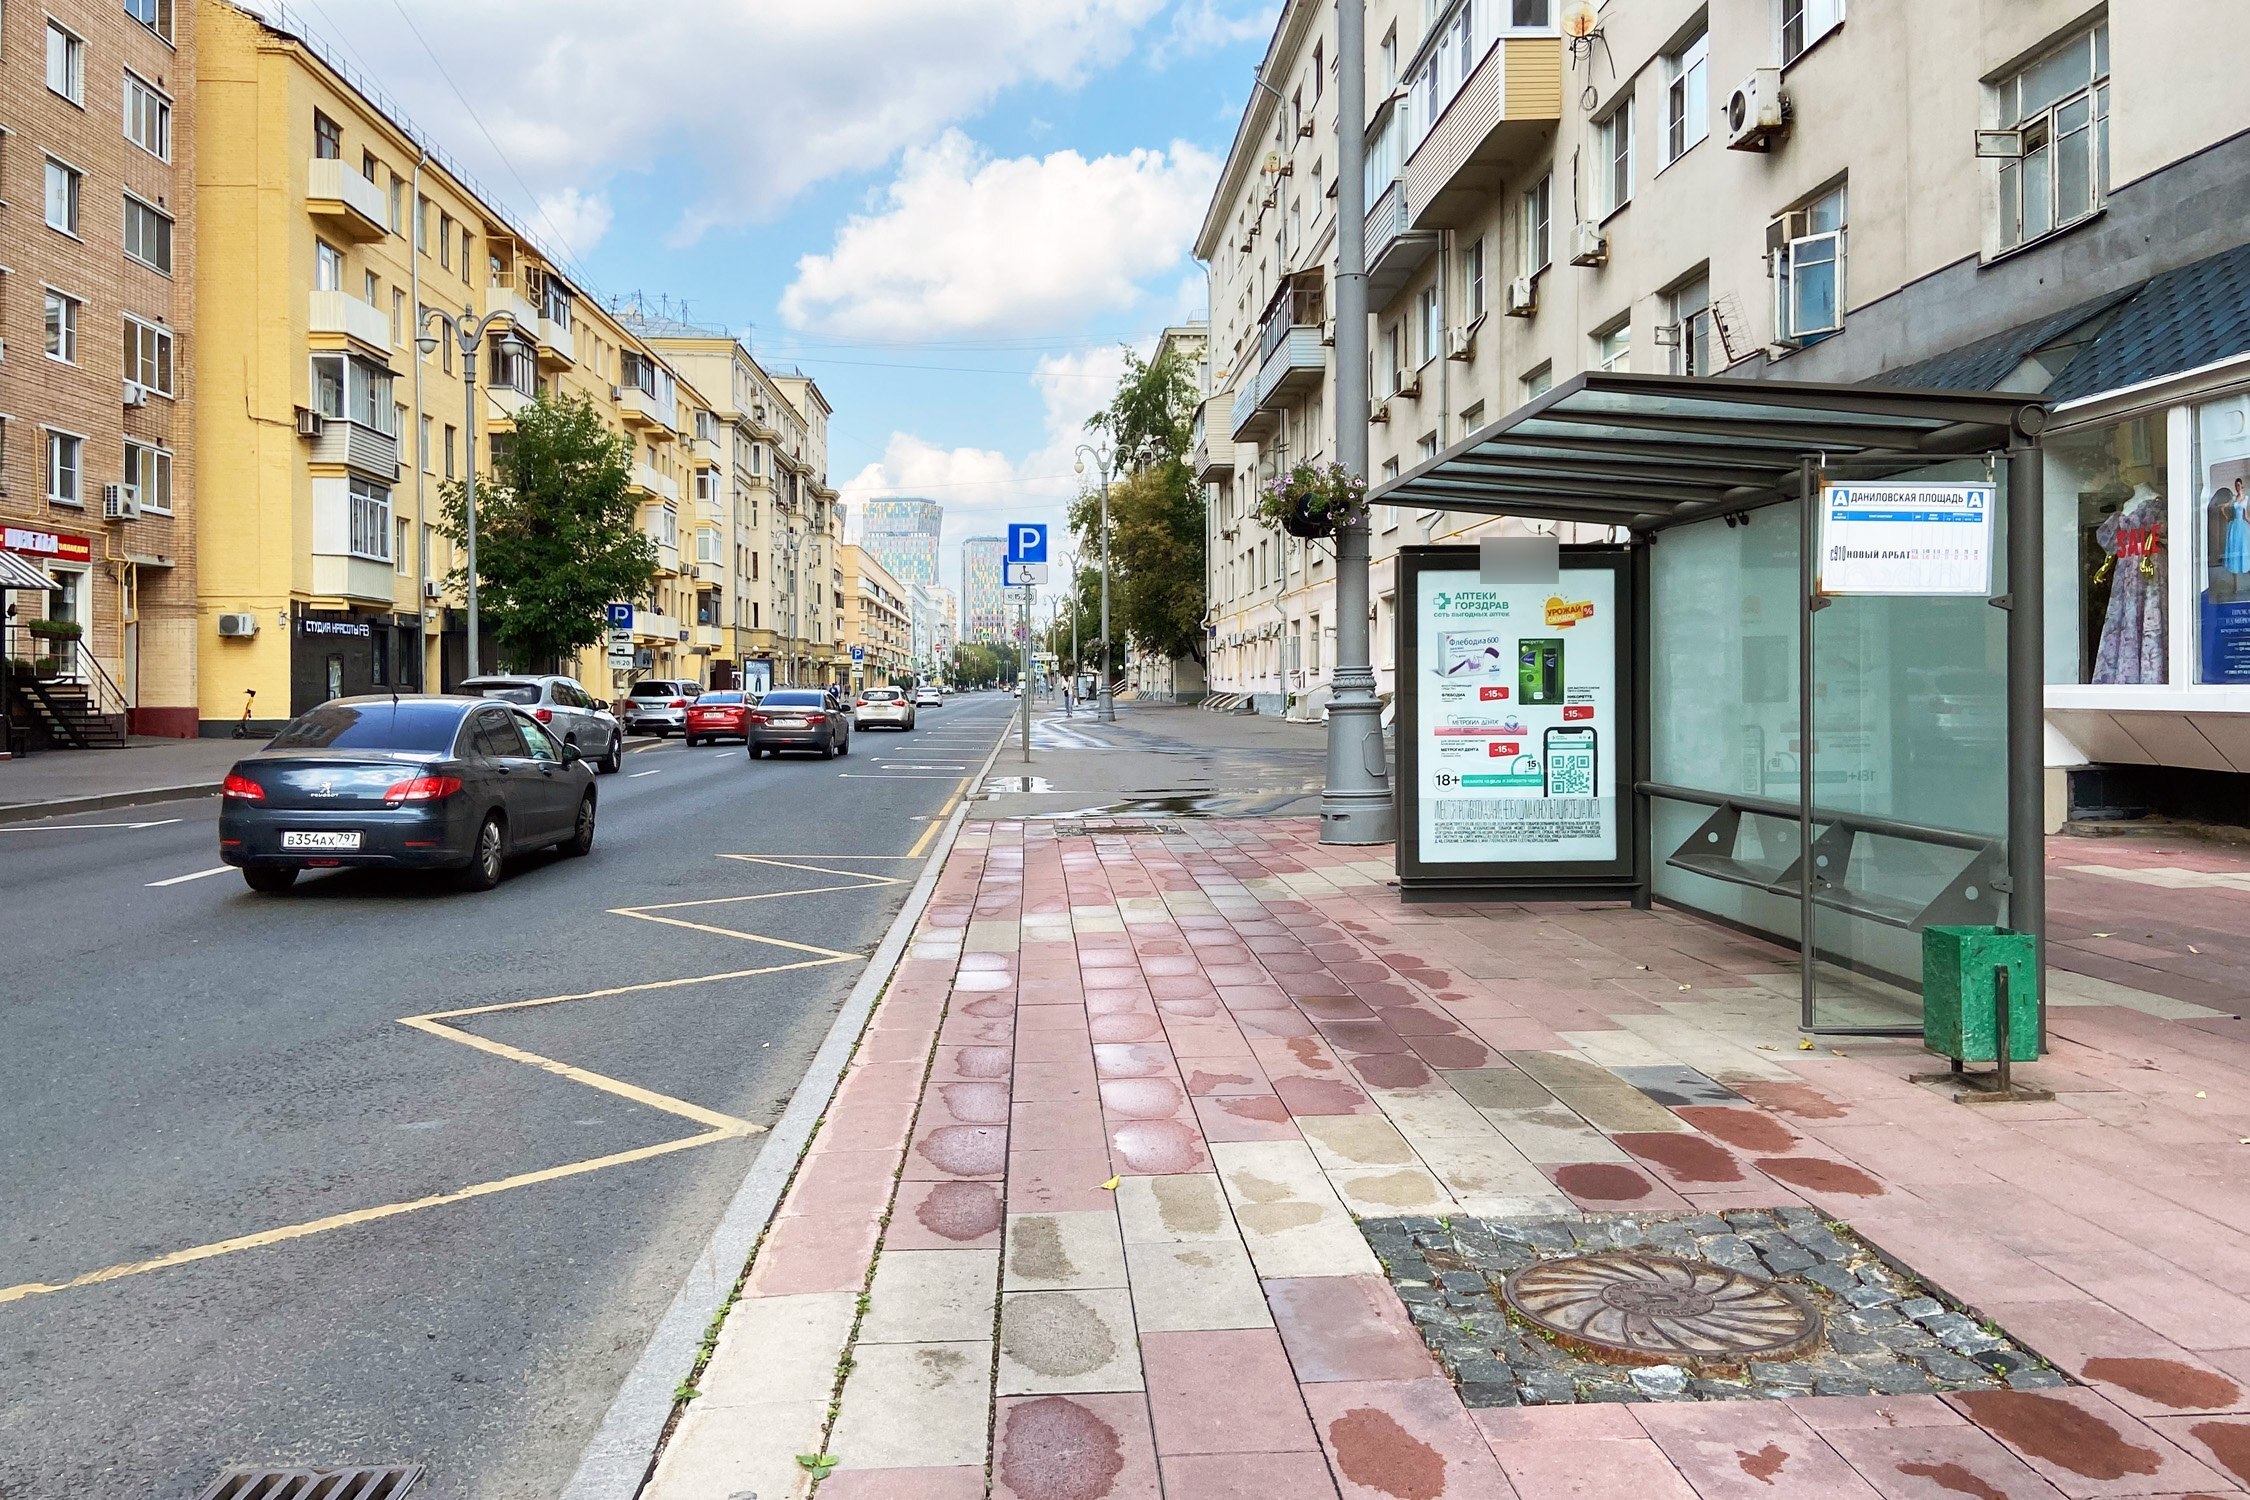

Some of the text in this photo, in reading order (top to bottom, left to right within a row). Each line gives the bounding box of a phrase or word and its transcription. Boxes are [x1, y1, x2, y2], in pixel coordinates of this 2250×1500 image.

[1851, 492, 1964, 503] ДАНИЛОВСКАЯ ПЛОЩАДЬ
[1019, 528, 1040, 558] P
[2117, 524, 2161, 558] SALE
[1847, 550, 1879, 559] НОВЫЙ
[1881, 550, 1911, 559] АРБАТ
[1455, 592, 1497, 600] АПТЕКИ
[1455, 601, 1509, 611] ГОРЗДРАВ
[1547, 604, 1582, 616] УРОЖАЙ
[615, 606, 629, 620] P
[305, 620, 332, 635] СТУДИЯ
[332, 622, 359, 636] КРАСОТЫ
[1449, 636, 1500, 646] Флебодиа 600
[854, 650, 862, 659] P
[1436, 774, 1460, 786] 18+
[337, 833, 357, 843] 797
